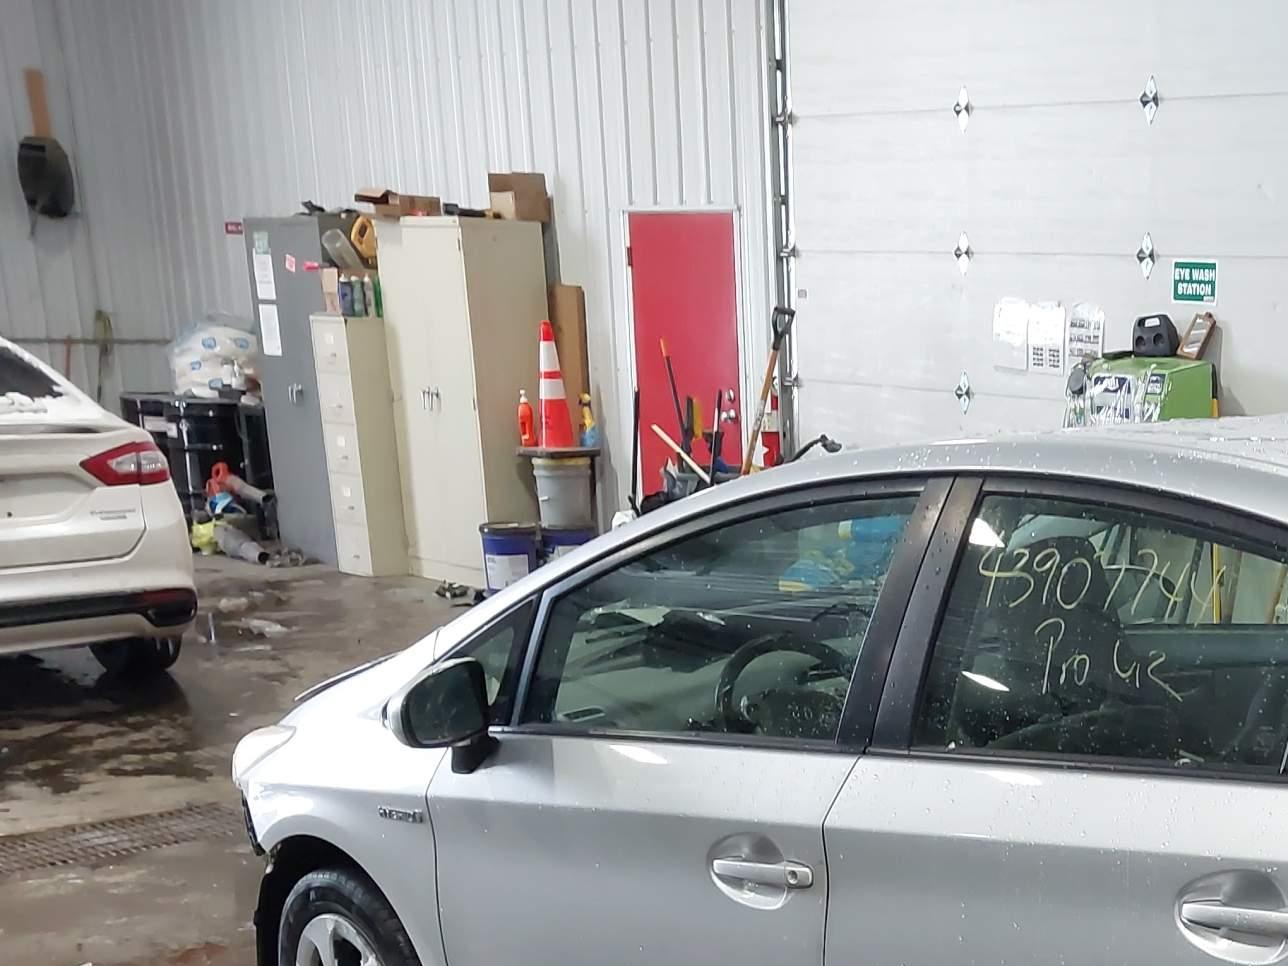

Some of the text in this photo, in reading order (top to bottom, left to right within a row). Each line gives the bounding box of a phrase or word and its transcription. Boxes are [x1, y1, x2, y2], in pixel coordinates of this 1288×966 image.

[1174, 268, 1216, 282] EYE WASH
[1177, 282, 1211, 295] STATION
